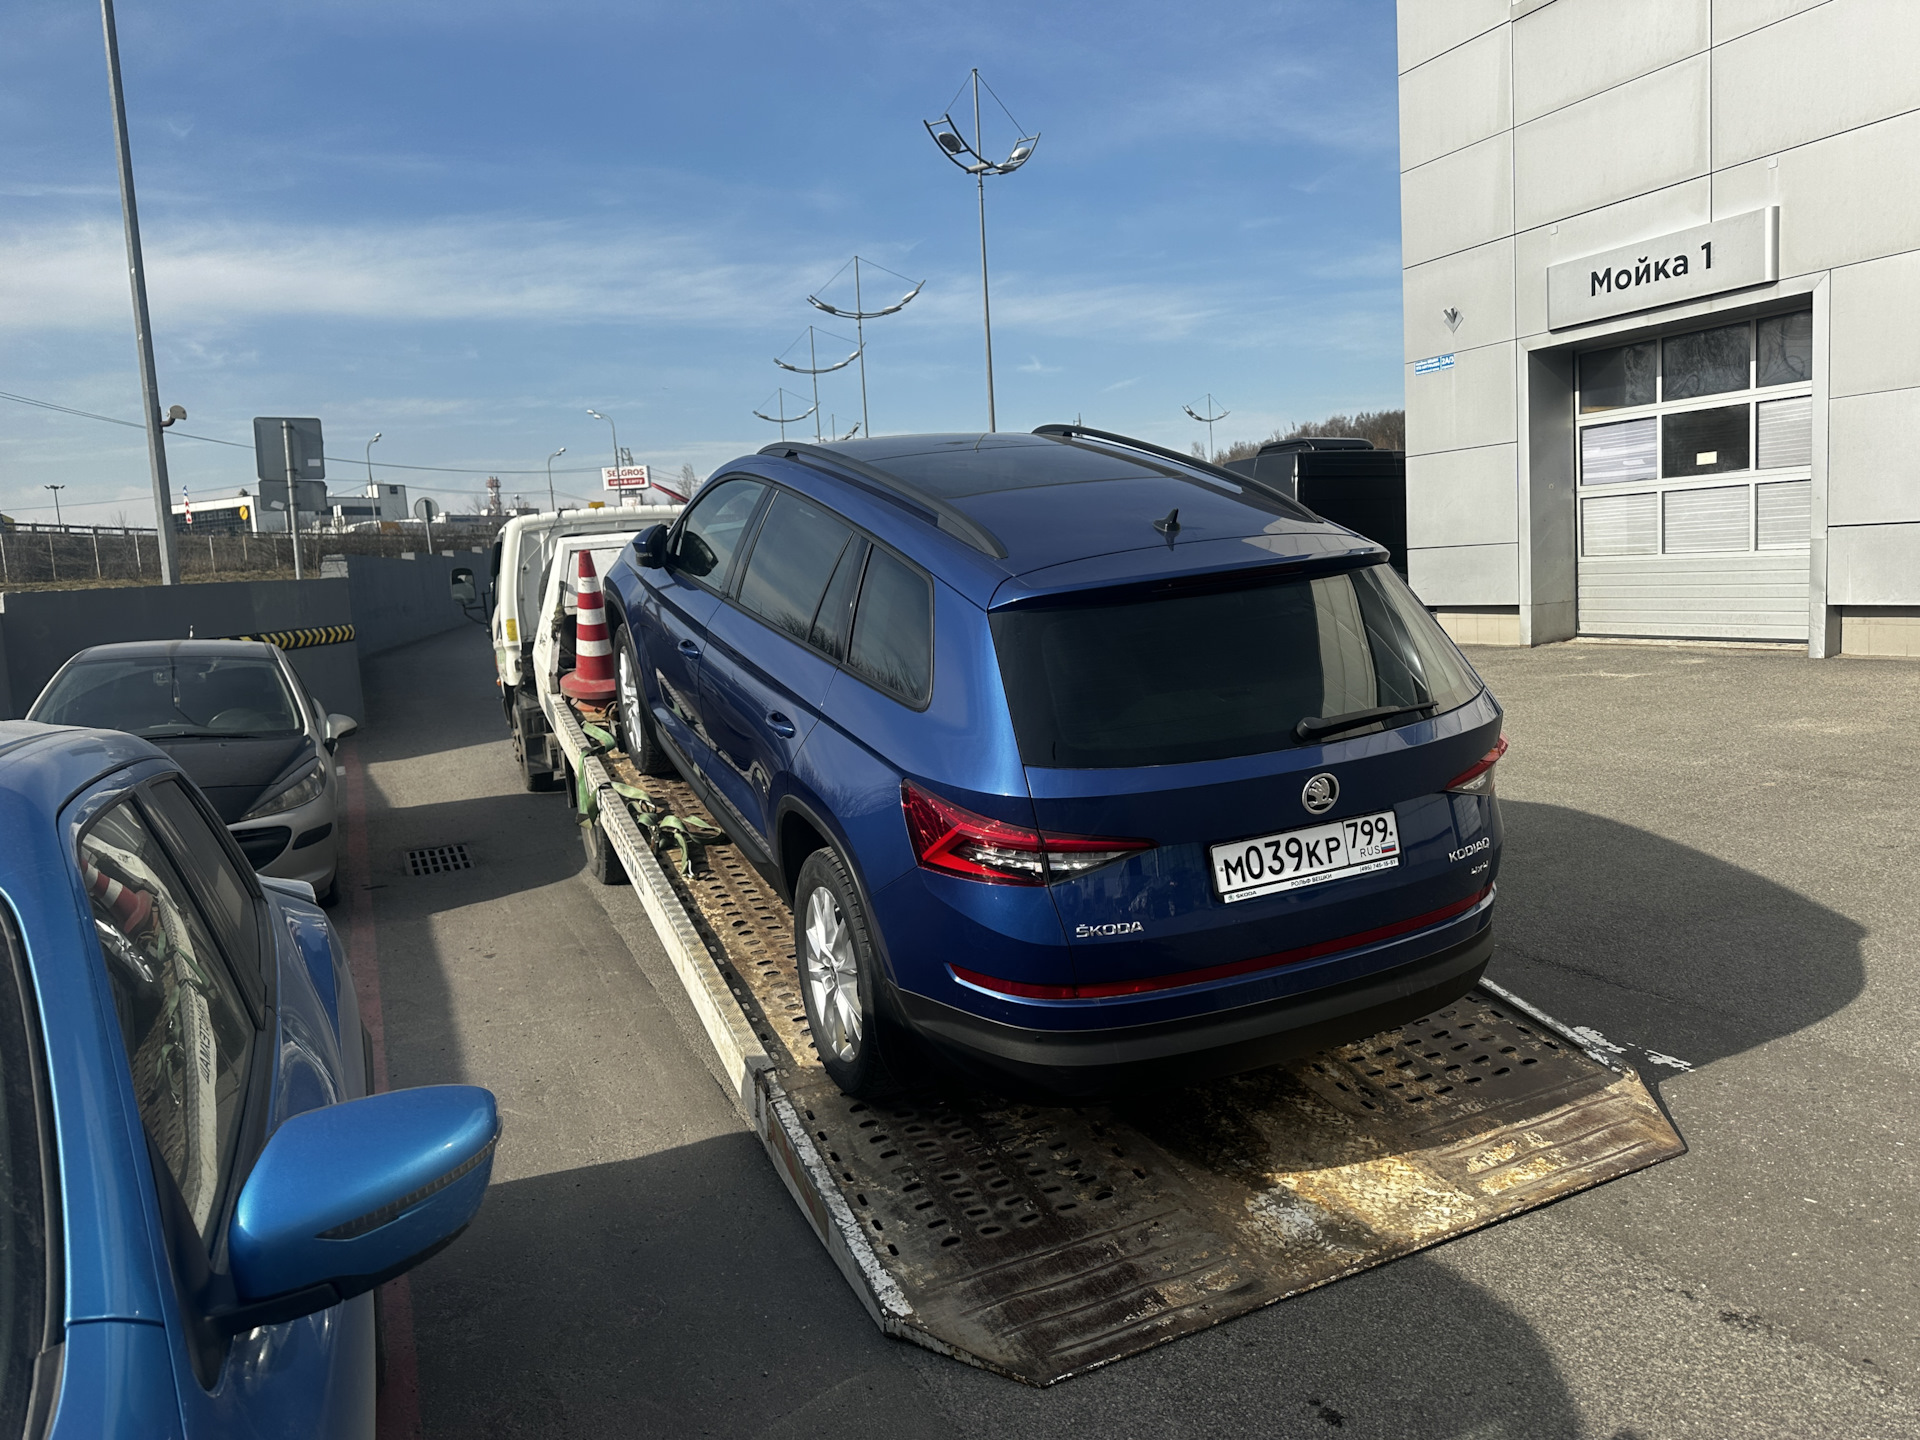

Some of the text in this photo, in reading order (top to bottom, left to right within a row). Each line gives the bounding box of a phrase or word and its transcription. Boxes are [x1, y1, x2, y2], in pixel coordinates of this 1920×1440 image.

[1591, 241, 1712, 297] Мойка 1
[1346, 817, 1388, 849] 799
[1223, 836, 1341, 886] М039КР
[1360, 845, 1381, 858] RUS
[1448, 837, 1490, 863] KODIAQ
[1290, 873, 1333, 888] РОЛЬФ ВЕШКИ
[1075, 921, 1145, 938] ŠKODA
